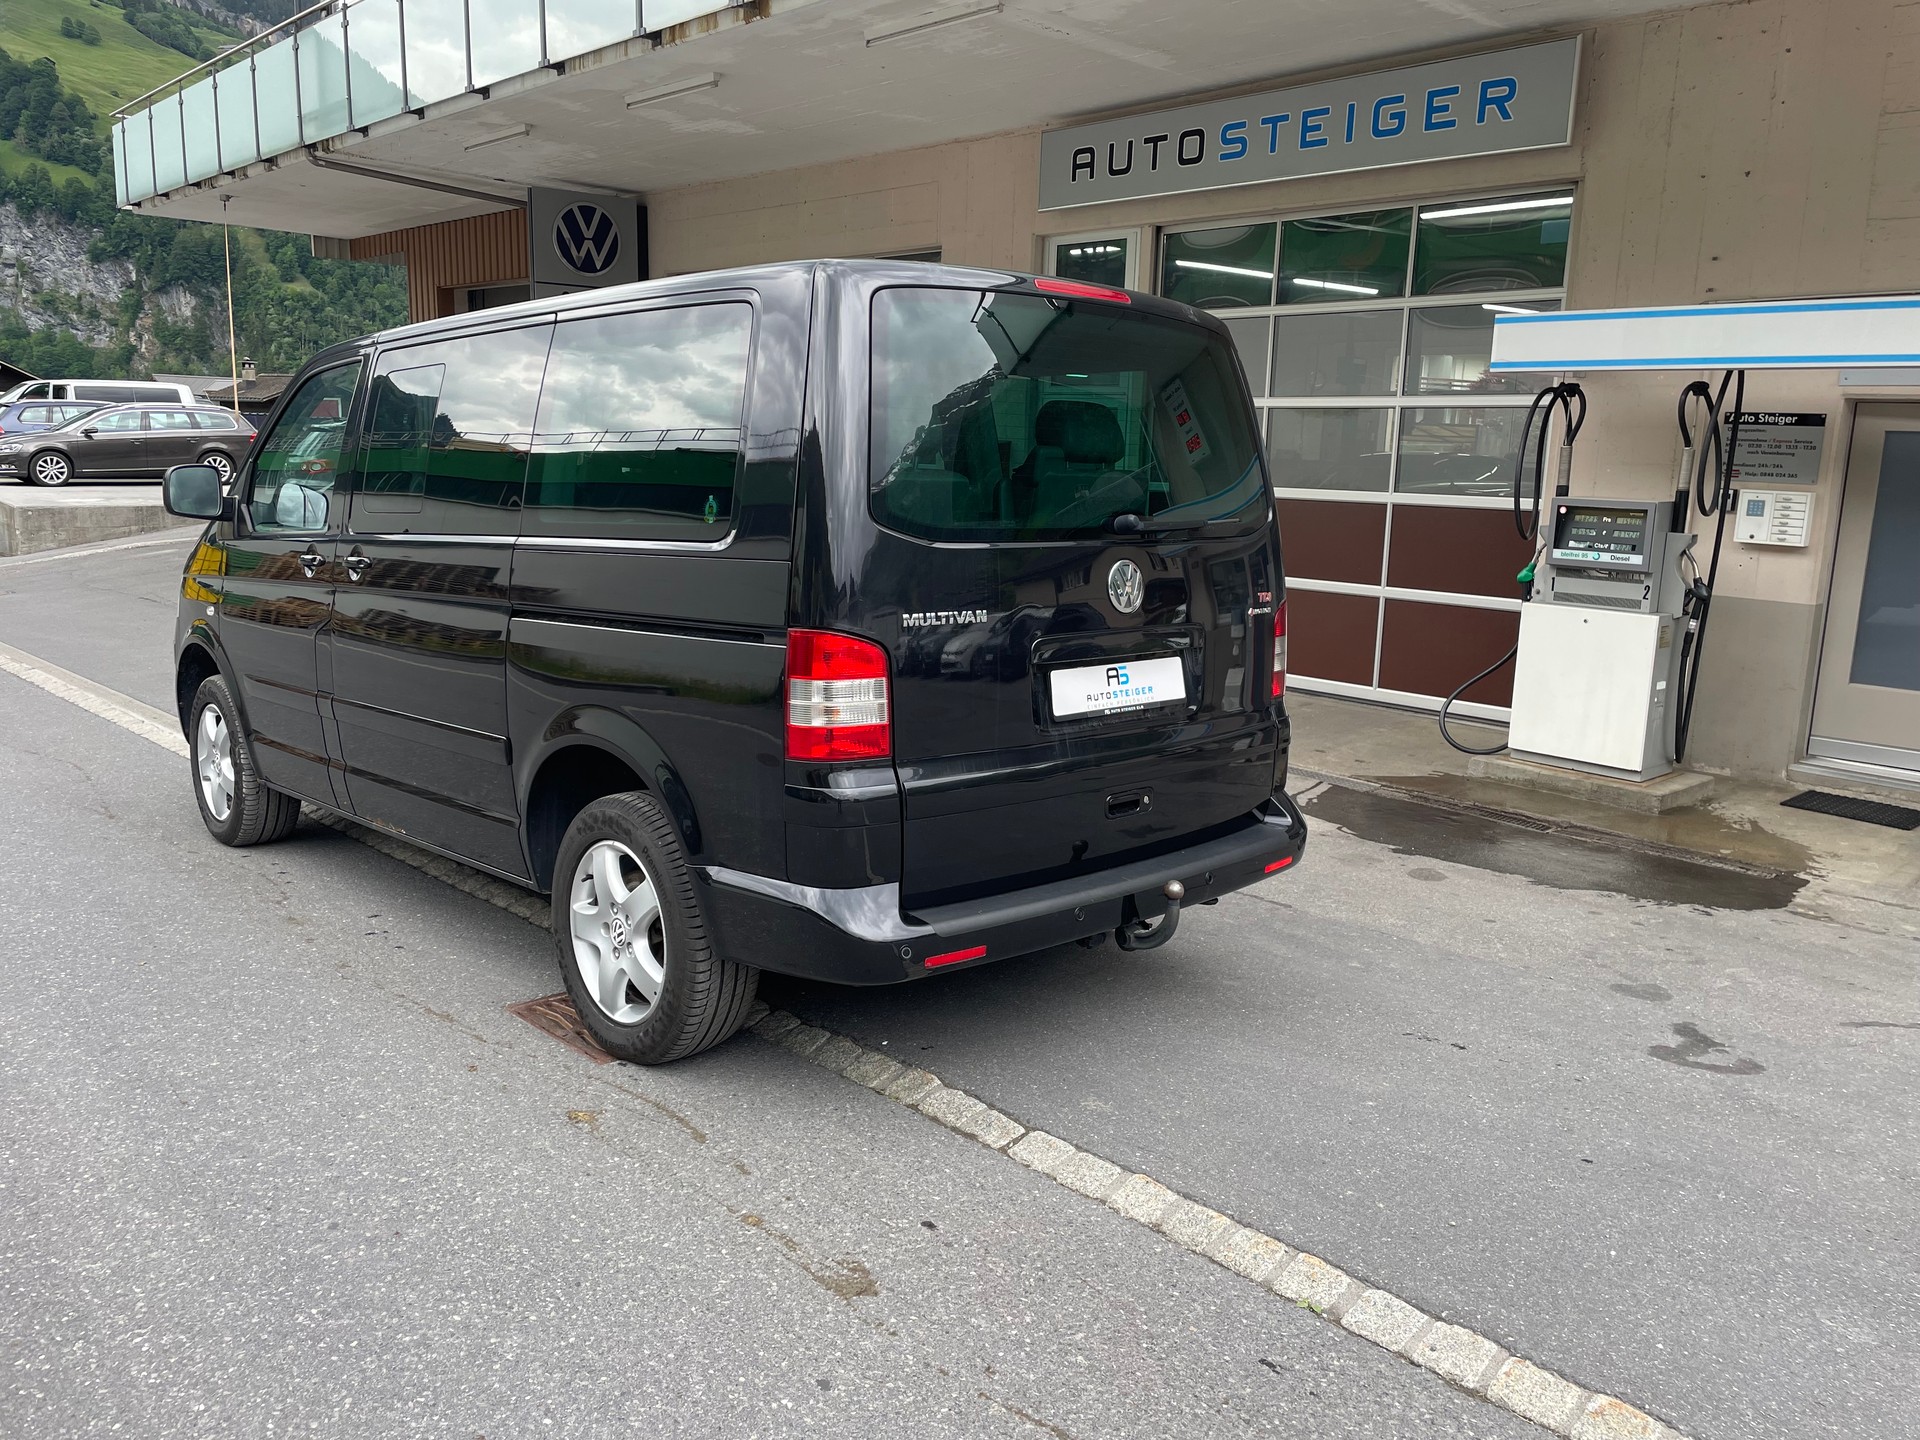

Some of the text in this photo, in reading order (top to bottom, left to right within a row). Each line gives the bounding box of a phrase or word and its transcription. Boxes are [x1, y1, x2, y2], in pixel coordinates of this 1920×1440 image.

[1071, 76, 1518, 183] AUTOSTEIGER
[1758, 413, 1798, 425] Steiger
[1610, 554, 1630, 562] Diesel
[1642, 584, 1651, 600] 2
[902, 609, 988, 628] MULTIVAN
[1086, 686, 1154, 703] AUTOSTEIGER
